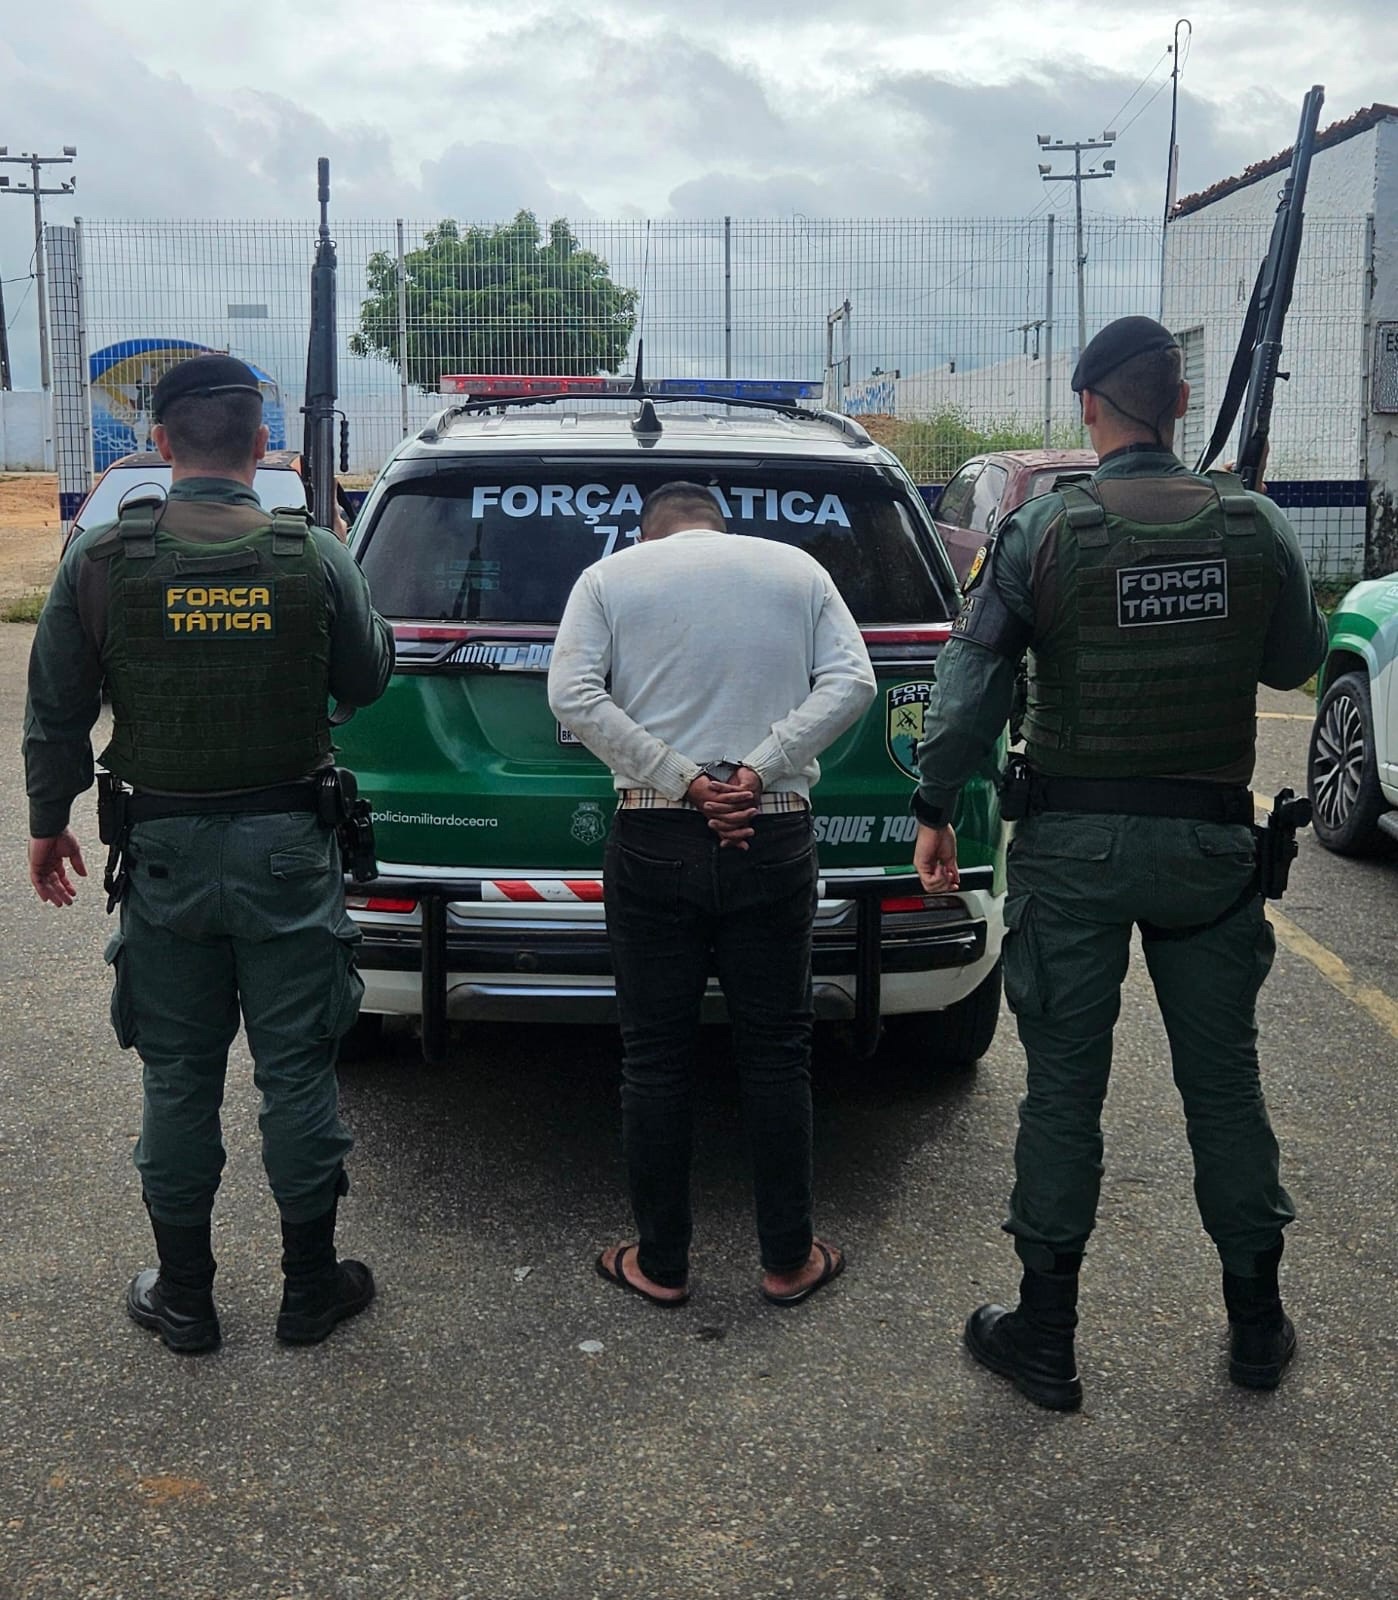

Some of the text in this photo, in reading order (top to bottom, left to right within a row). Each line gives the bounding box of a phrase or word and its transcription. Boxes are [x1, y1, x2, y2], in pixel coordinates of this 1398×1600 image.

[471, 483, 643, 525] FORÇA
[1121, 567, 1222, 596] FORÇA
[167, 587, 270, 608] FORÇA
[1122, 592, 1224, 619] TÁTICA
[167, 609, 272, 632] TÁTICA
[879, 815, 919, 843] 190
